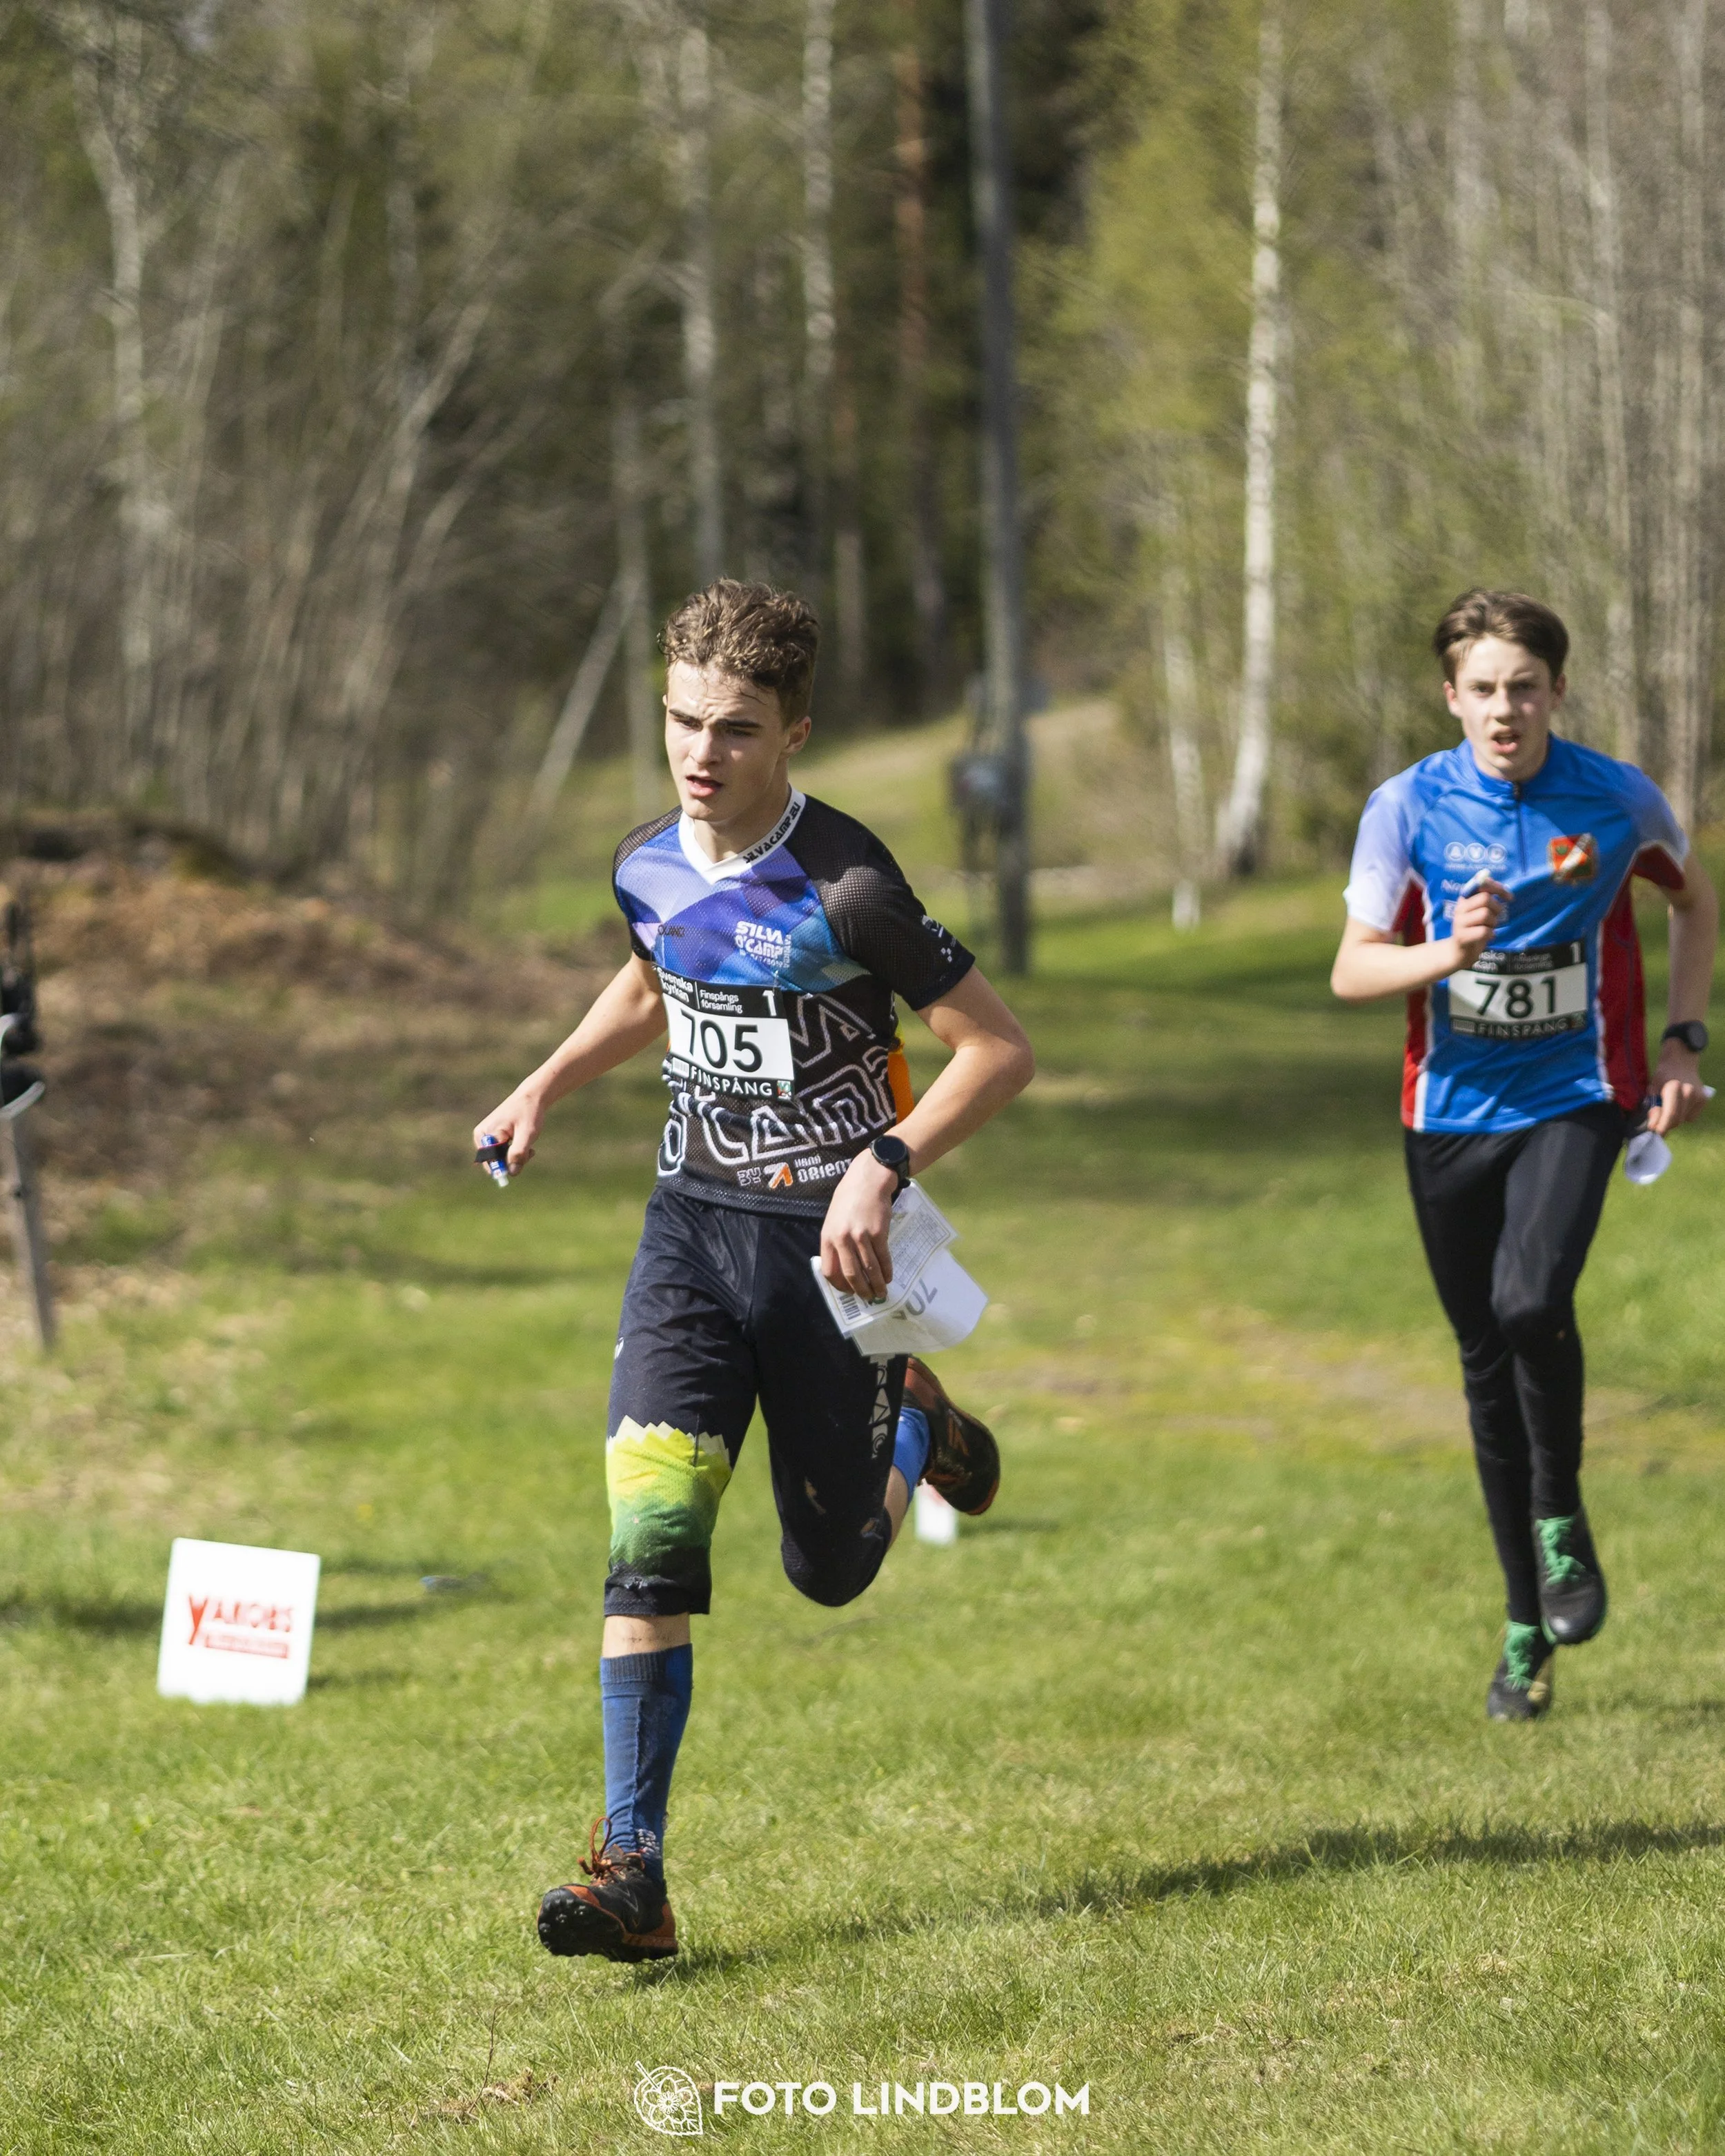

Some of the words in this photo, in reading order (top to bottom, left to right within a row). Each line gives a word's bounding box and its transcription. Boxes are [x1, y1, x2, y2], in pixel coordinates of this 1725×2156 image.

[736, 920, 783, 945] SILVA
[1570, 941, 1581, 964] 1
[657, 967, 694, 993] Svenska
[662, 980, 689, 1002] kyrkan
[700, 989, 739, 1004] Finspångs
[700, 998, 743, 1013] församling
[762, 990, 777, 1016] 1
[1474, 976, 1556, 1019] 781
[680, 1008, 763, 1073] 705
[690, 1065, 773, 1096] FINSPÅNG
